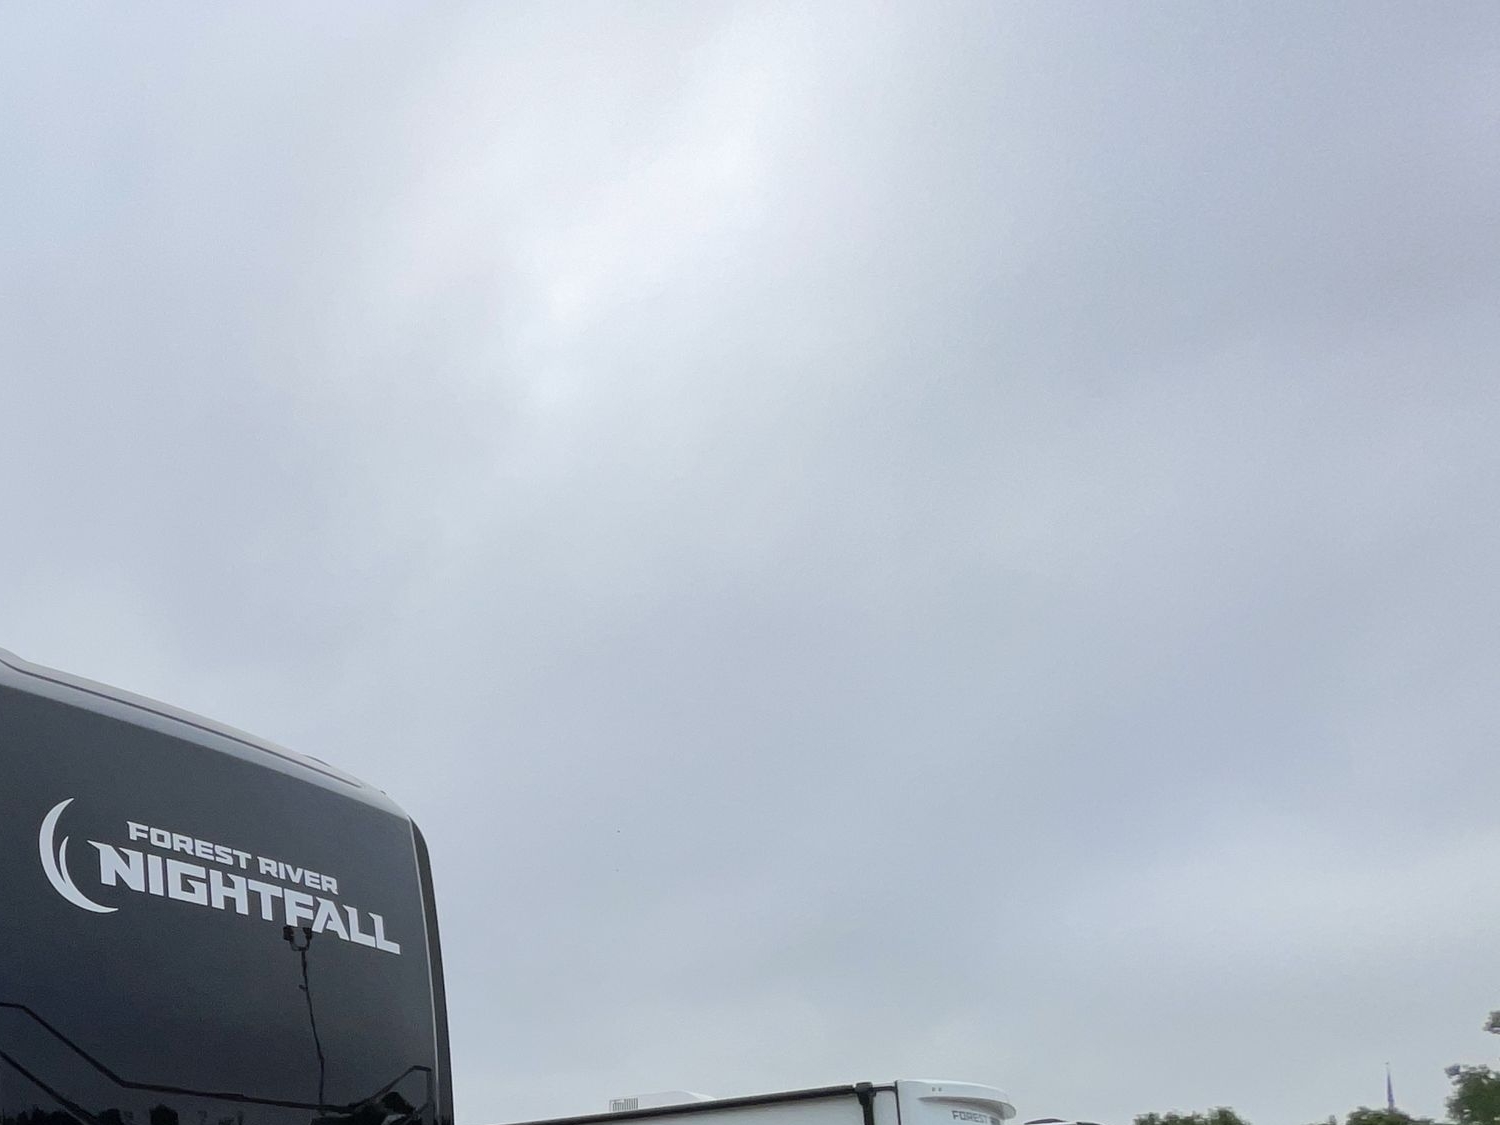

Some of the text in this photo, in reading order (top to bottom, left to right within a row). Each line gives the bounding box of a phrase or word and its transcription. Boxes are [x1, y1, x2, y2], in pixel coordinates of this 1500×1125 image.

[87, 839, 401, 955] NIGHTFALL
[126, 820, 339, 895] FOREST RIVER
